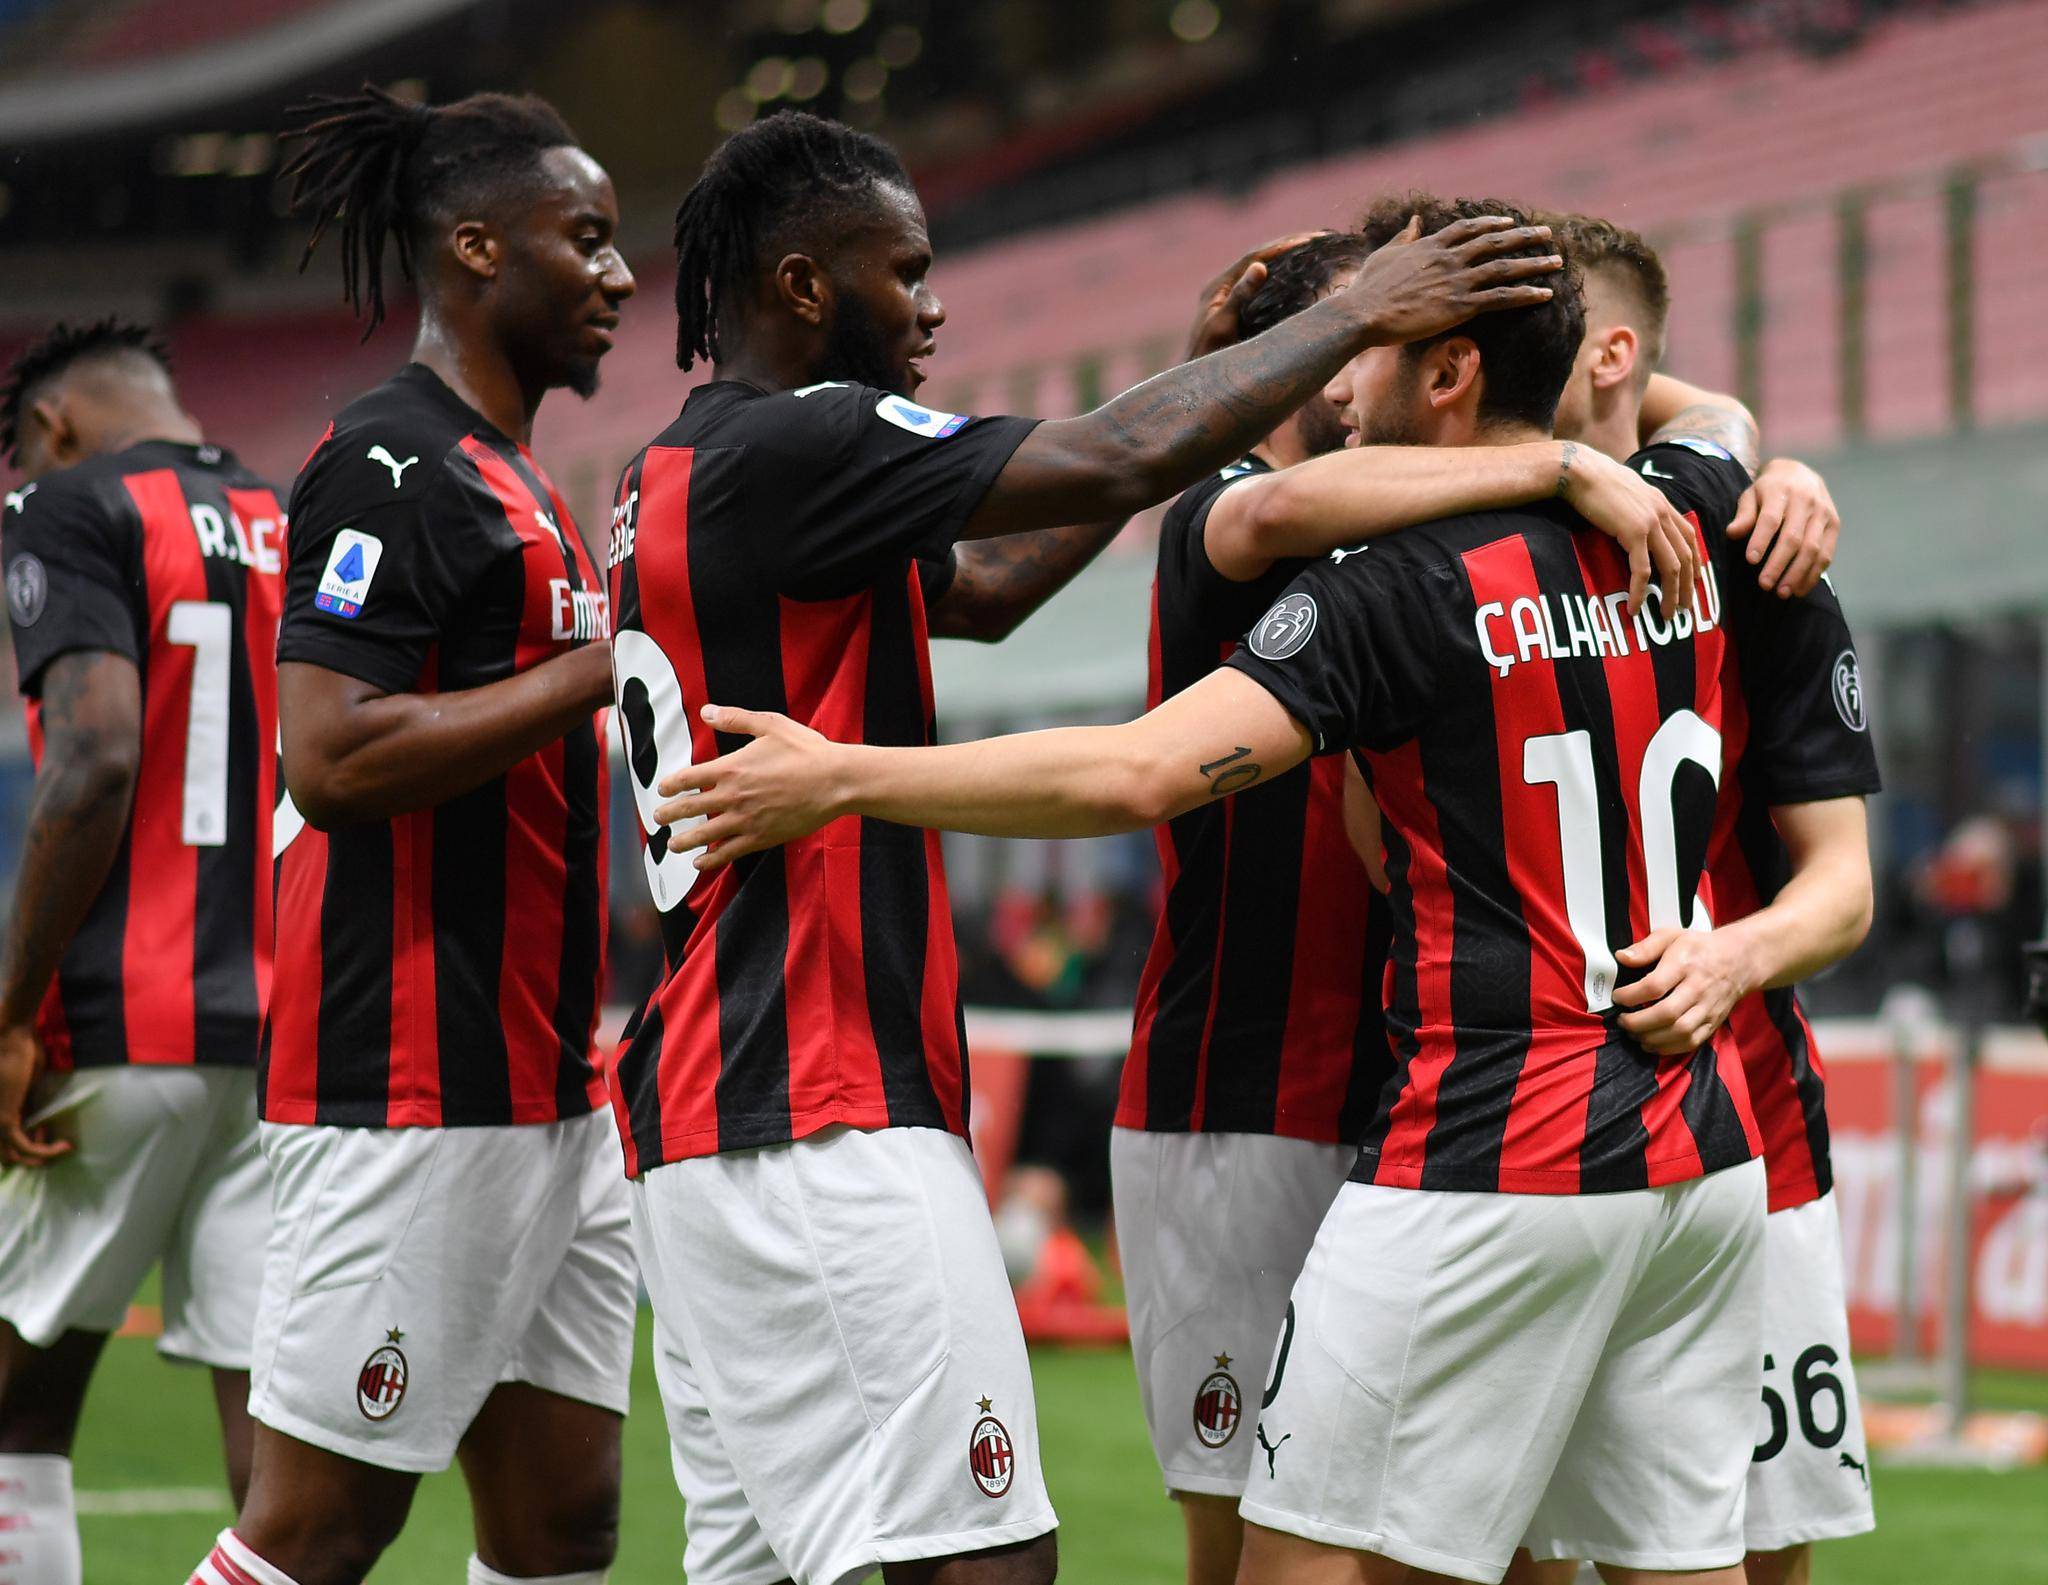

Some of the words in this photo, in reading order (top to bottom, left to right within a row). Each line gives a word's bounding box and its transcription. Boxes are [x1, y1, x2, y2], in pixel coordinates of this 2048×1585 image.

[190, 503, 289, 575] R.LE
[1270, 622, 1289, 640] 7
[1199, 746, 1262, 796] 10
[1523, 709, 1723, 1014] 10
[986, 1477, 1006, 1488] 1899
